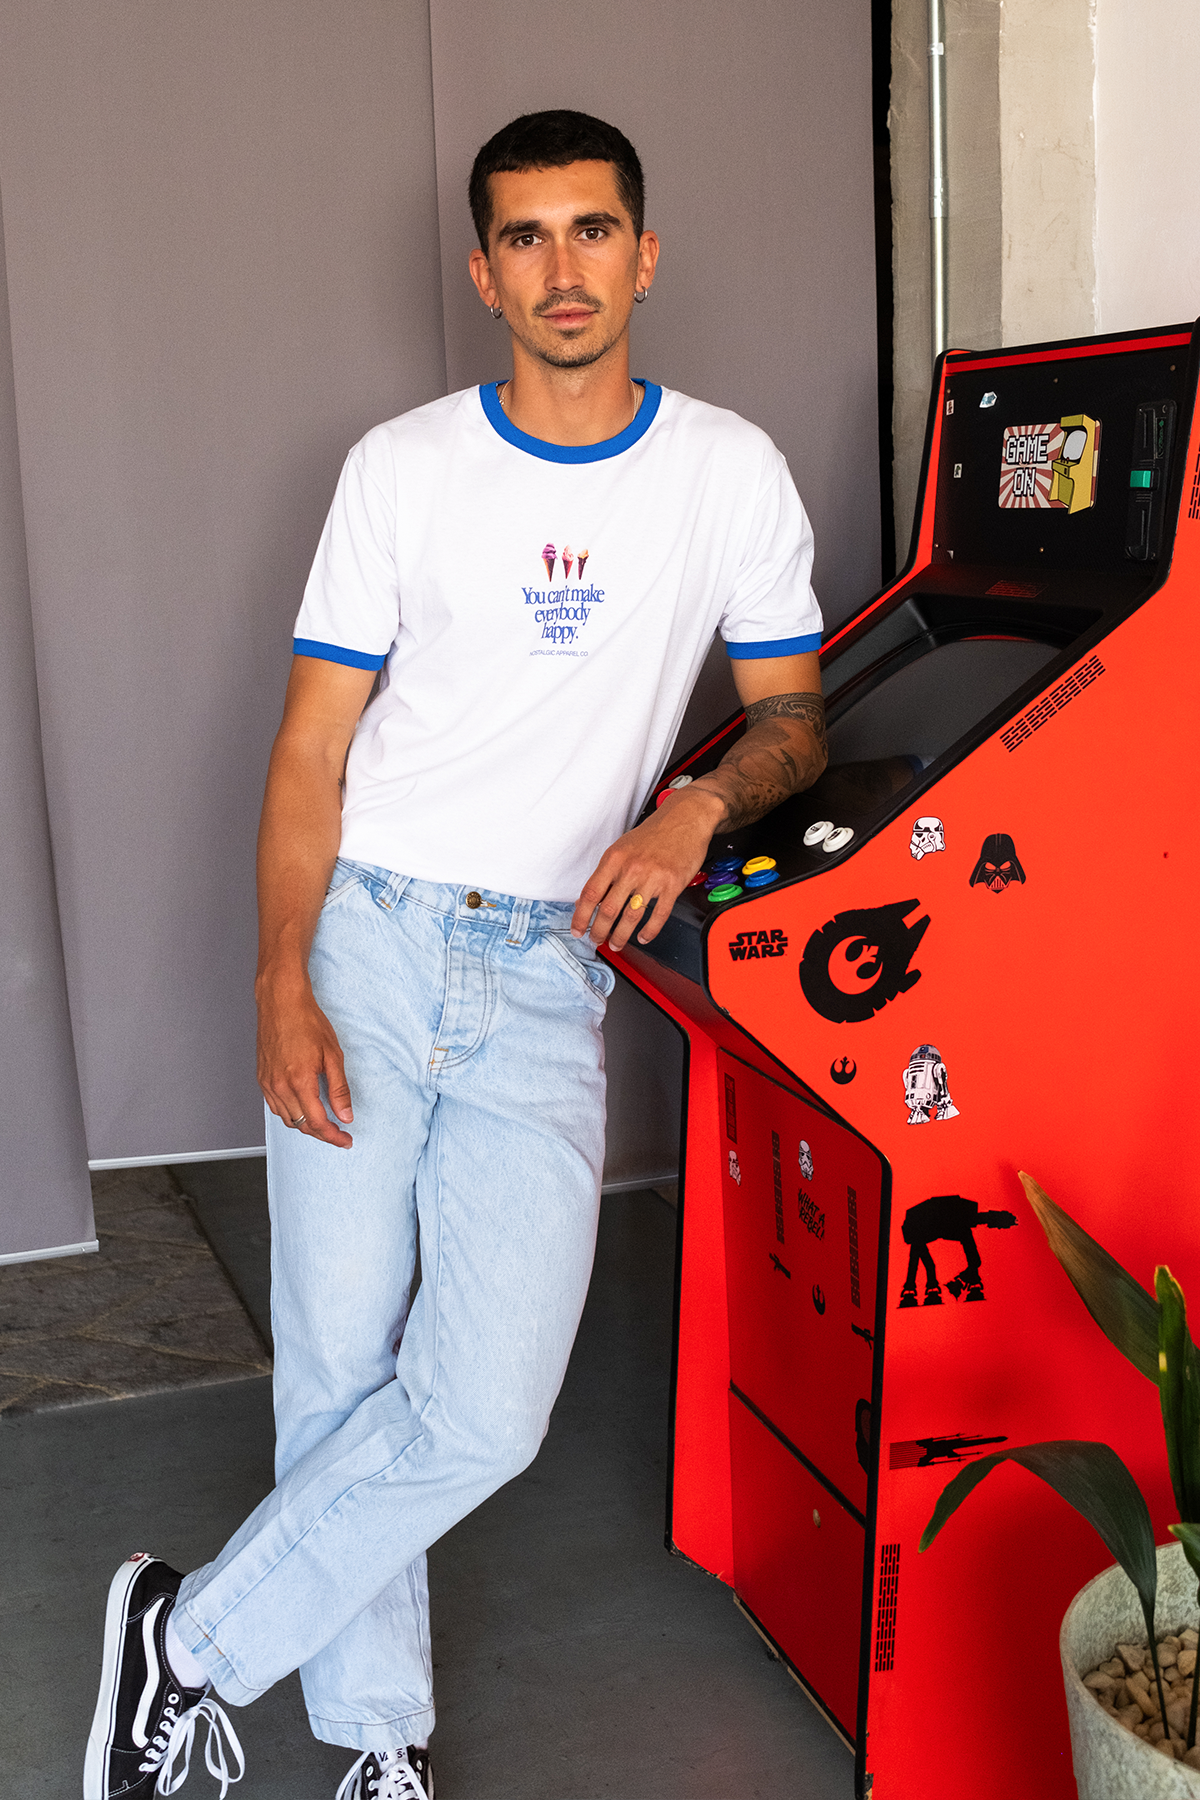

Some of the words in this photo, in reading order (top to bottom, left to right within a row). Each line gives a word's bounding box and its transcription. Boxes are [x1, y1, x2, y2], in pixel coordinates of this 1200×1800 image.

[1005, 433, 1050, 465] GAME
[1013, 467, 1037, 497] ON
[521, 587, 546, 605] You
[571, 583, 605, 603] make
[534, 602, 591, 626] everybody
[541, 621, 578, 644] happy.
[529, 649, 556, 657] NOSTALGIC
[729, 929, 788, 947] STAR
[729, 943, 788, 961] WARS
[798, 1188, 820, 1217] WHAT
[818, 1213, 825, 1228] A
[799, 1206, 825, 1241] REBEL!
[378, 1748, 403, 1762] VS
